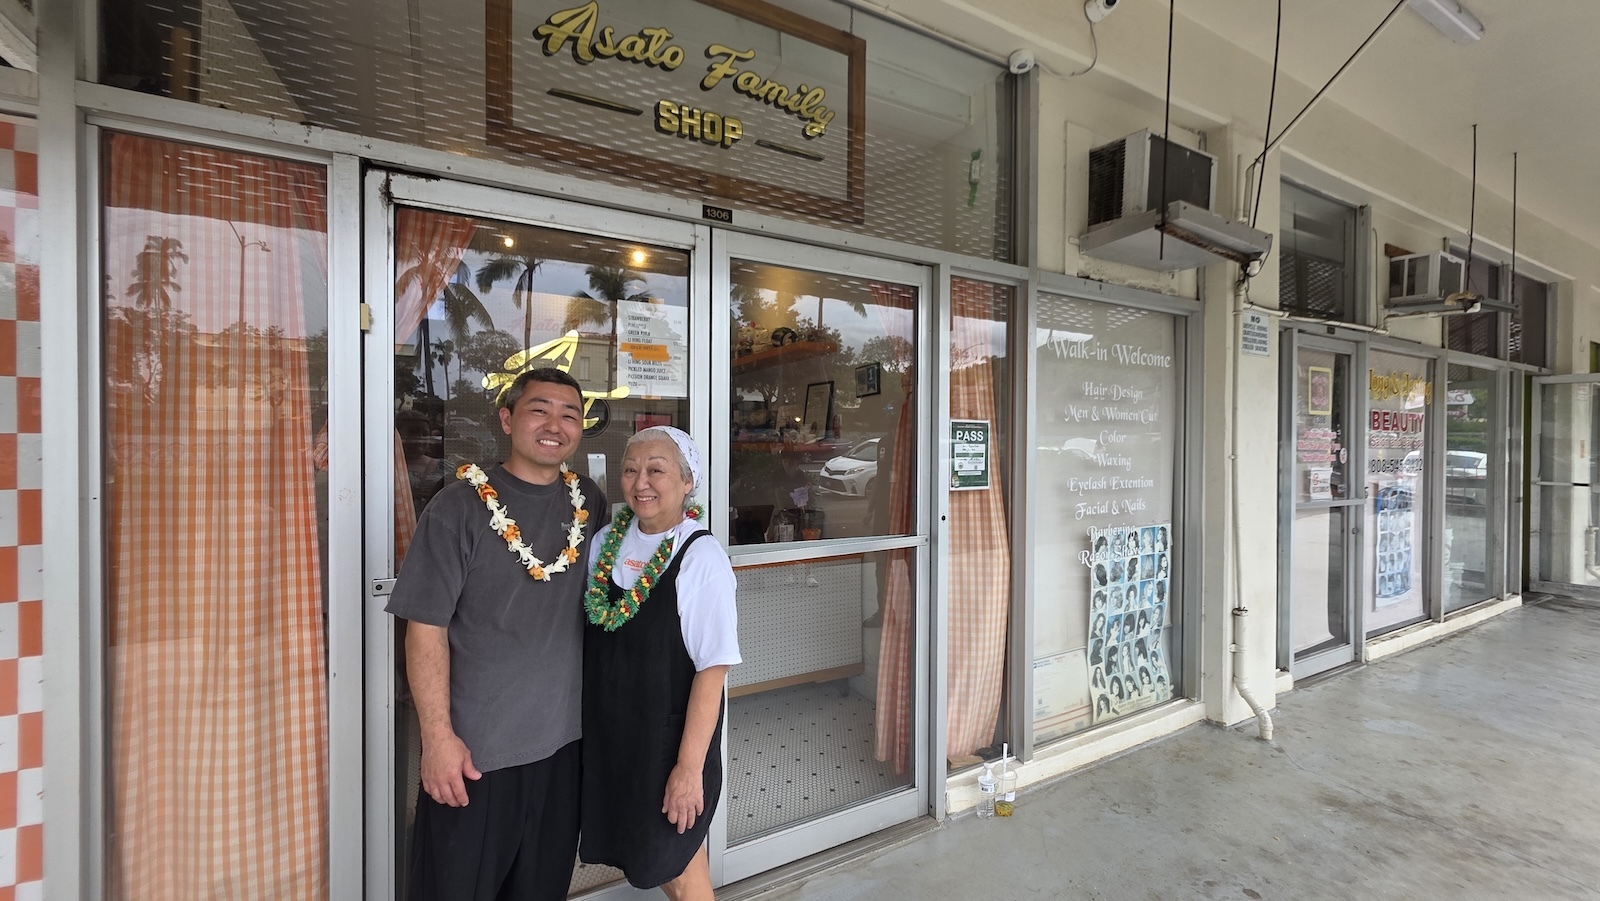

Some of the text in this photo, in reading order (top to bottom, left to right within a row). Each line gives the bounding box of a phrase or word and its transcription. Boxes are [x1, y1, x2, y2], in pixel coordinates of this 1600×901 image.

[533, 0, 835, 140] Asato Family
[654, 99, 743, 149] SHOP
[706, 208, 730, 220] 1306
[1047, 337, 1171, 368] Walk-in Welcome
[1082, 382, 1143, 404] Hair Design
[1064, 405, 1088, 422] Men
[1091, 406, 1100, 421] &
[1102, 406, 1138, 421] Women
[1370, 410, 1424, 432] BEAUTY
[956, 430, 984, 442] PASS
[1099, 430, 1126, 446] Color
[1094, 453, 1132, 471] Waxing
[1067, 476, 1154, 496] Eyelash Extention
[1075, 498, 1146, 520] Facial & Nails
